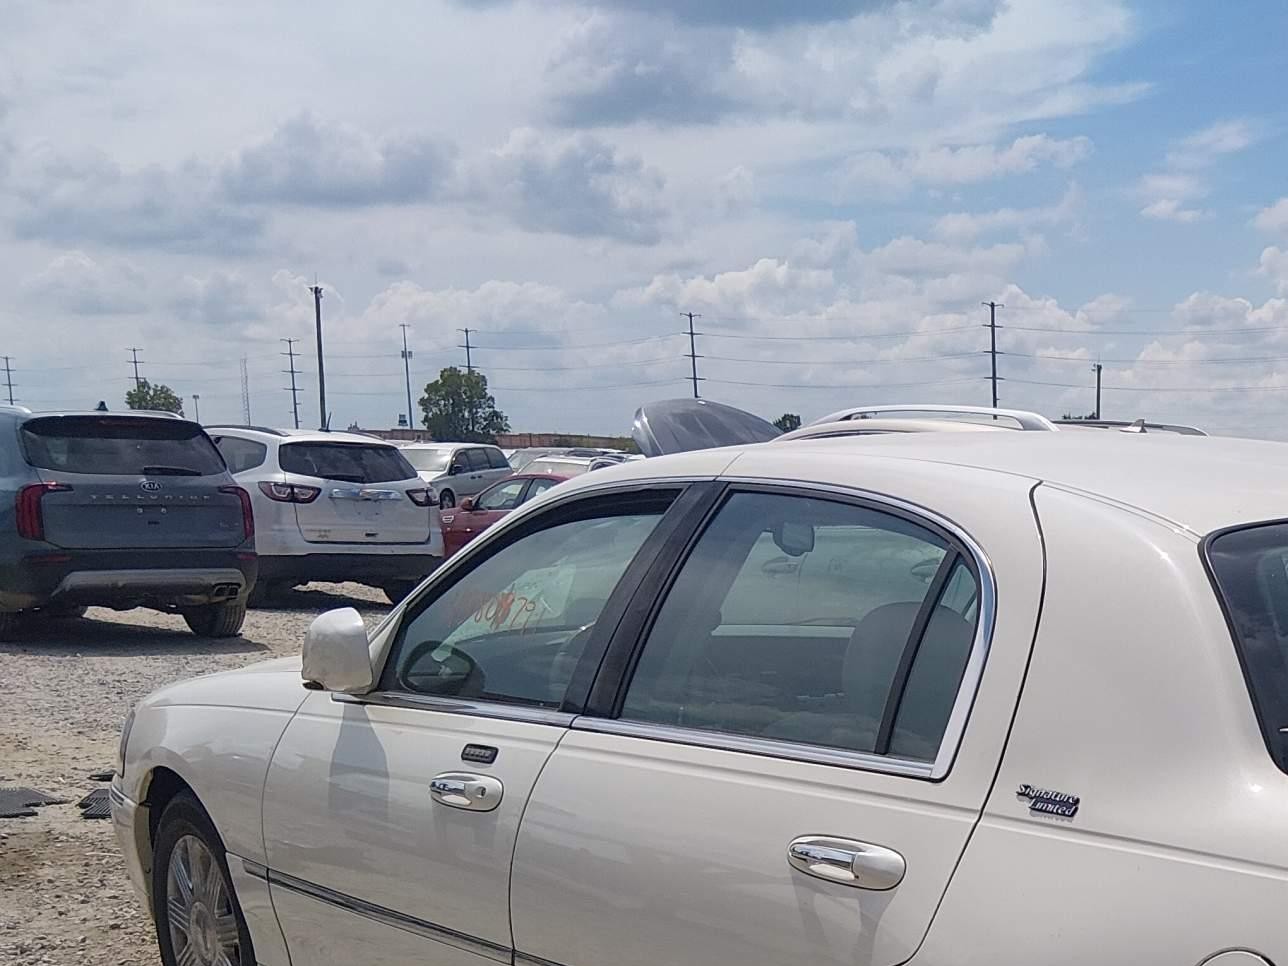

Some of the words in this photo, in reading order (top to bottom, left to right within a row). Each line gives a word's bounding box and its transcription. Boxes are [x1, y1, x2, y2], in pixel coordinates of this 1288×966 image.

[142, 481, 162, 491] KIA
[1017, 784, 1079, 805] Signature
[1029, 798, 1077, 816] Limited
